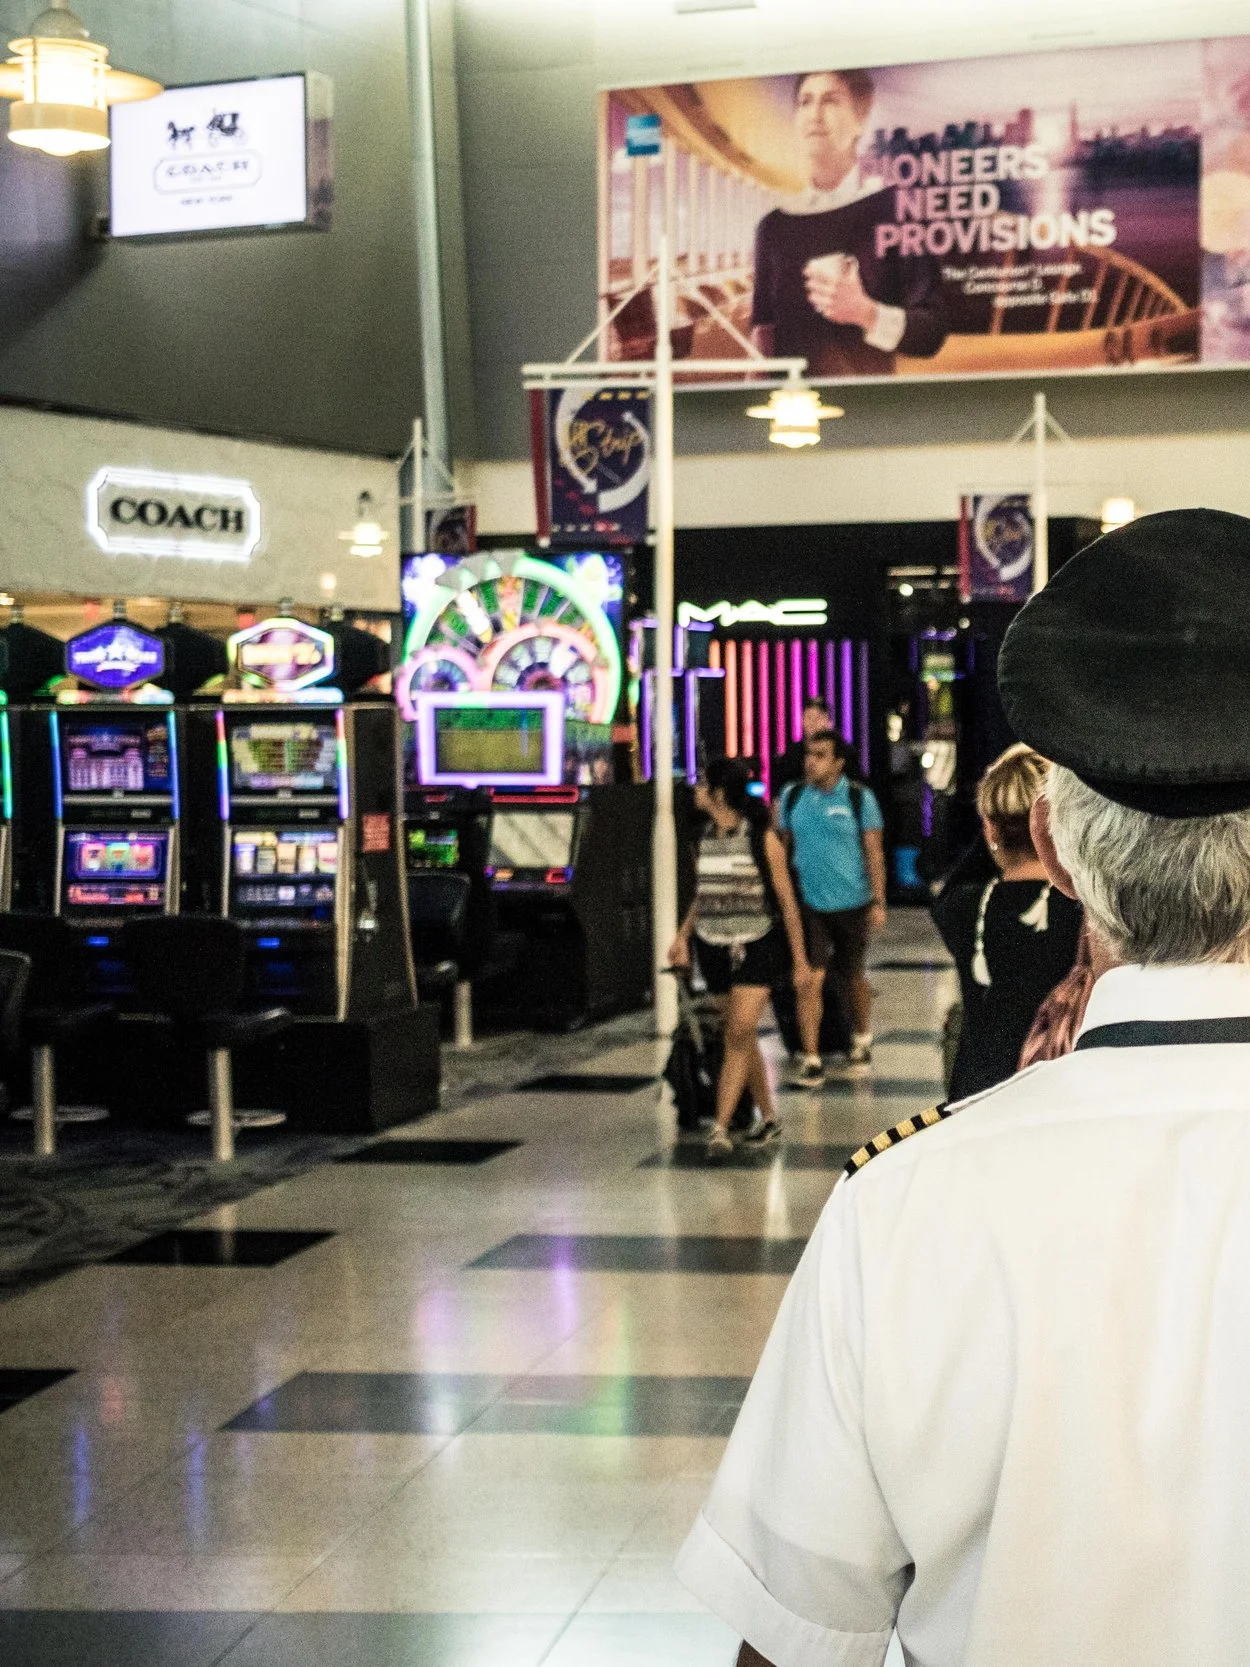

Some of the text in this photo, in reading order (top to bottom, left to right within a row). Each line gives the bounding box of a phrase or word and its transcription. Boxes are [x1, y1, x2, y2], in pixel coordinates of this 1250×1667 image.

[166, 160, 249, 177] COACH
[895, 183, 999, 222] NEED
[874, 208, 1118, 258] PROVISIONS
[110, 496, 244, 532] COACH
